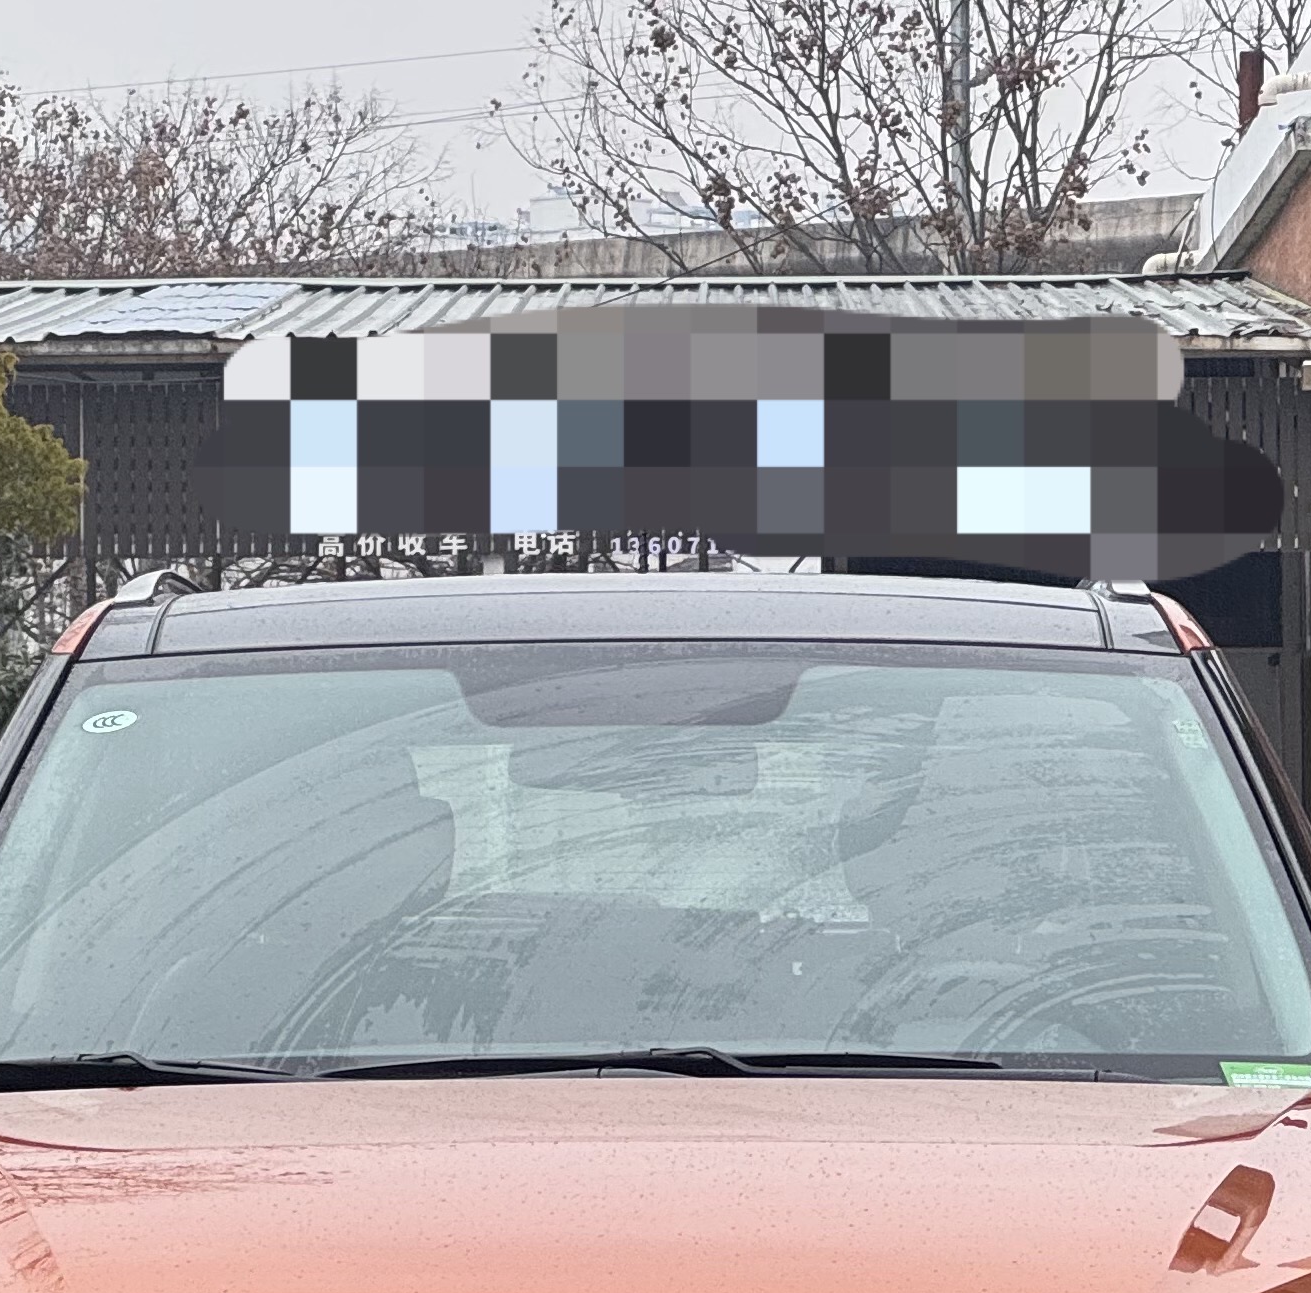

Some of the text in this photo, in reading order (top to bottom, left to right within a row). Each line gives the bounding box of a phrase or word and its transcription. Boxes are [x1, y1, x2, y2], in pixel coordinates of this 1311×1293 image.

[317, 532, 735, 557] 高价收车 电话 136071
